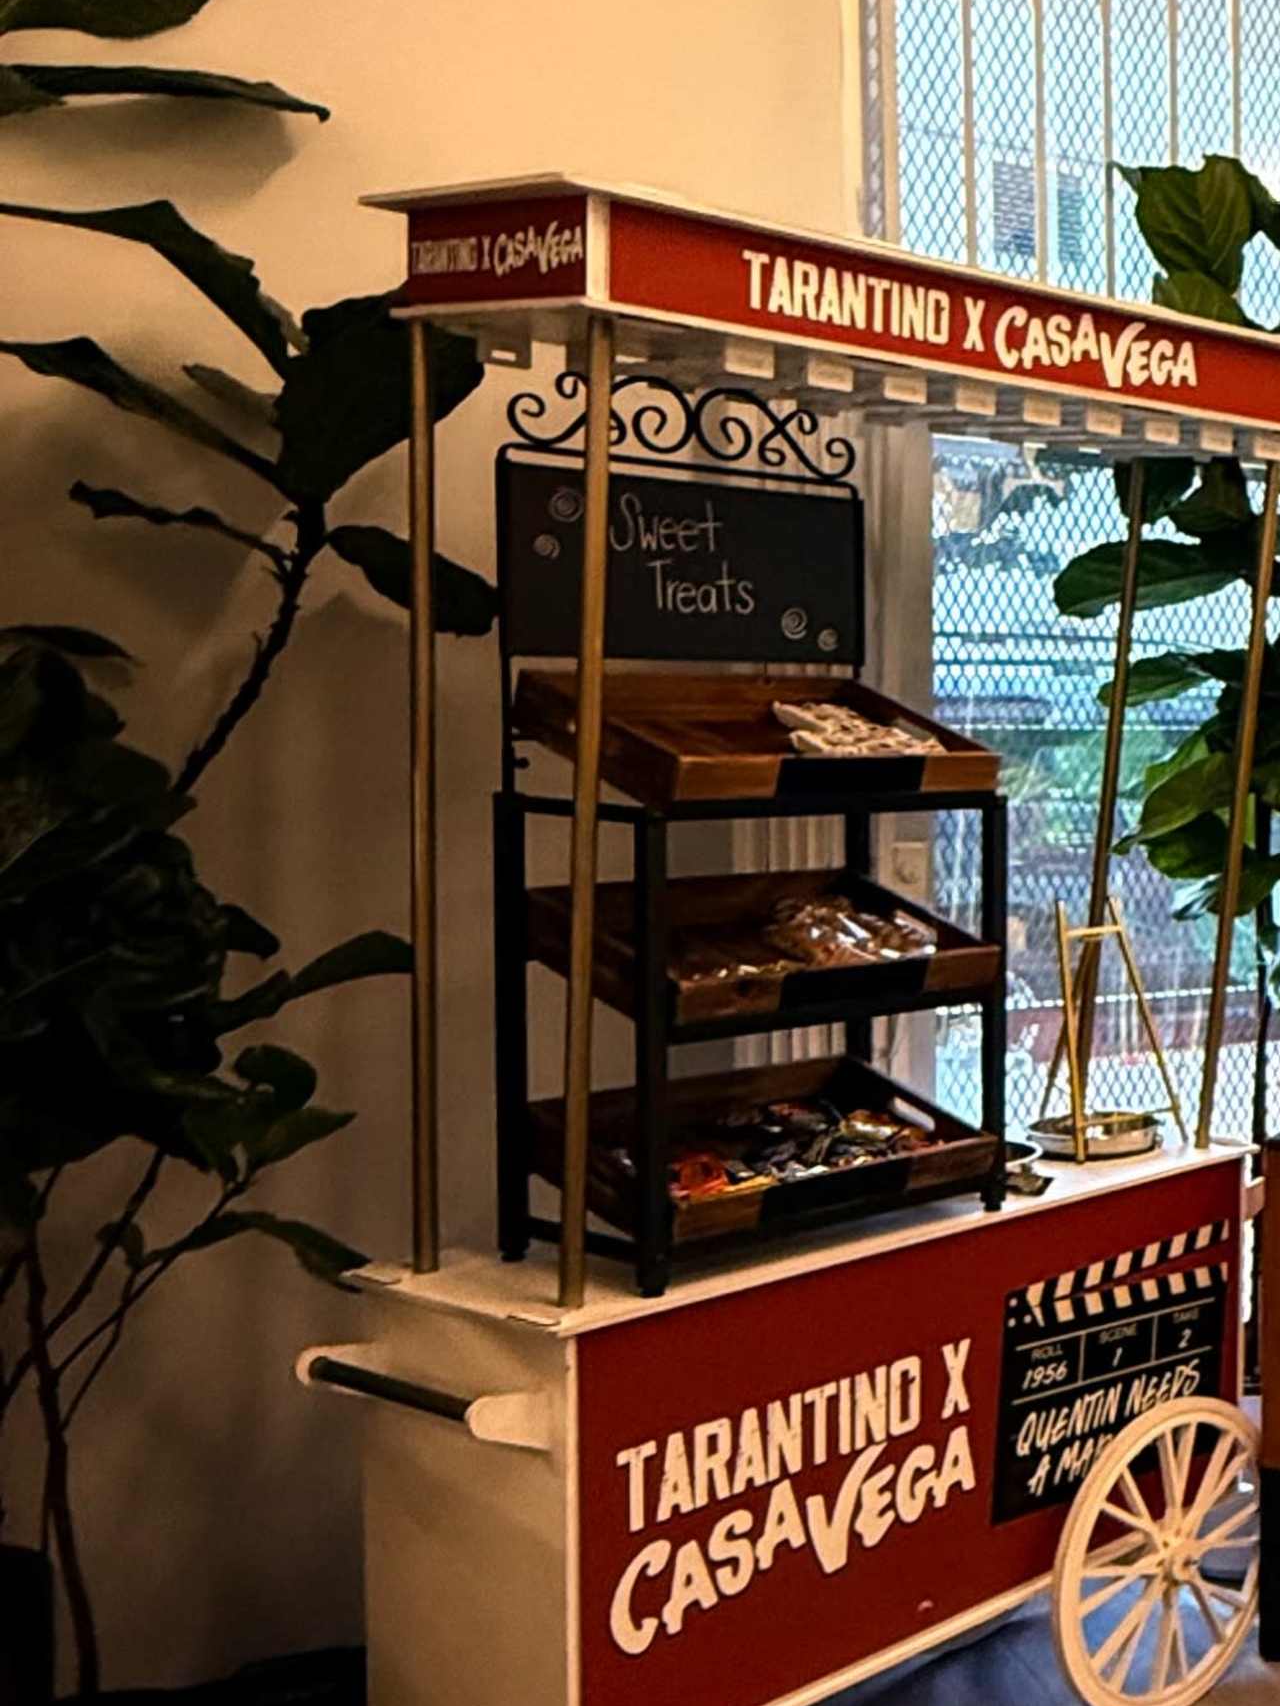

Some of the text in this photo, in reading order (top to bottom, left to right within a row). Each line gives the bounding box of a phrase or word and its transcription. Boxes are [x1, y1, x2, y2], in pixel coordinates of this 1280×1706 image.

[742, 250, 950, 345] TARANTINO
[962, 296, 986, 352] X
[609, 493, 723, 552] Sweet
[646, 558, 755, 614] Treats
[1031, 1345, 1063, 1360] ROLL
[1113, 1347, 1123, 1367] 1
[1178, 1328, 1192, 1349] 2
[1022, 1360, 1069, 1390] 1956
[1016, 1359, 1200, 1456] QUENTIN NEEDS
[616, 1337, 971, 1533] TARANTINO X
[1027, 1454, 1051, 1496] A
